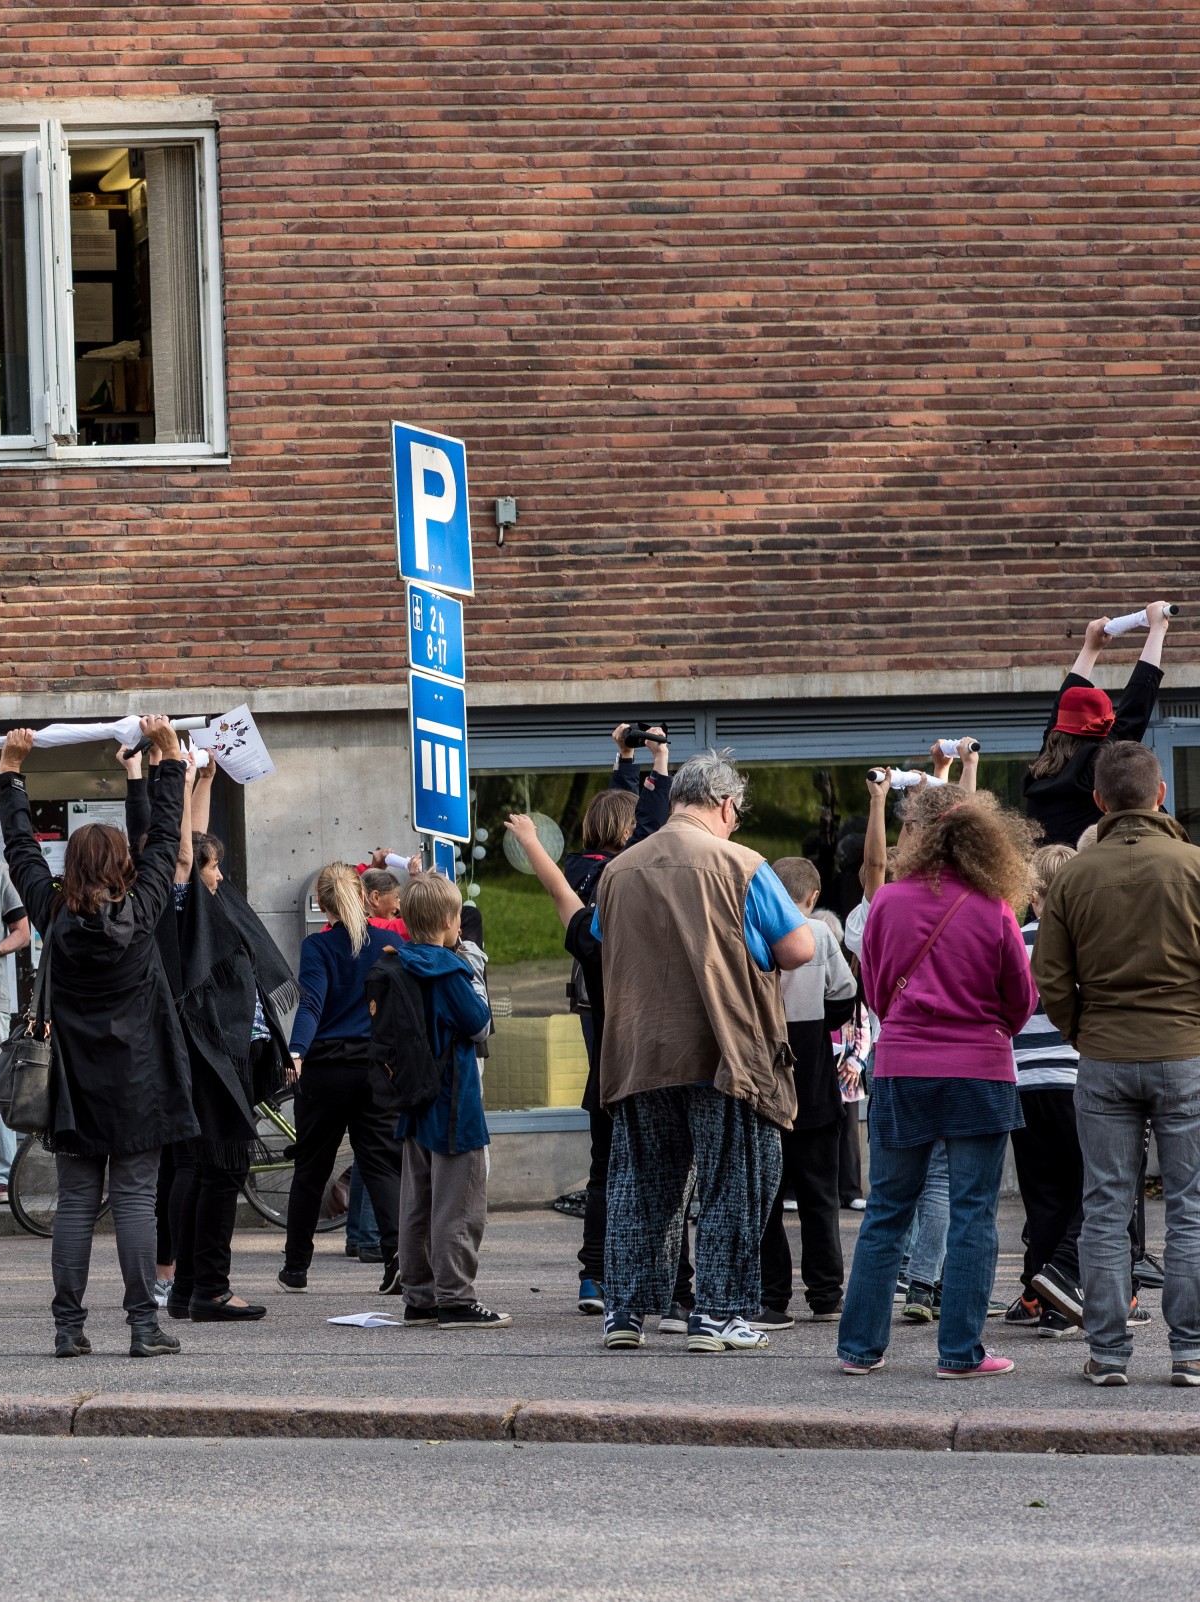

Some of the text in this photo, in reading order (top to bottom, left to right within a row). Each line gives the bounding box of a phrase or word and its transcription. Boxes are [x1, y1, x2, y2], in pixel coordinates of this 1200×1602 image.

[410, 441, 456, 572] P
[430, 605, 445, 635] 2 h
[427, 634, 446, 665] 8-17
